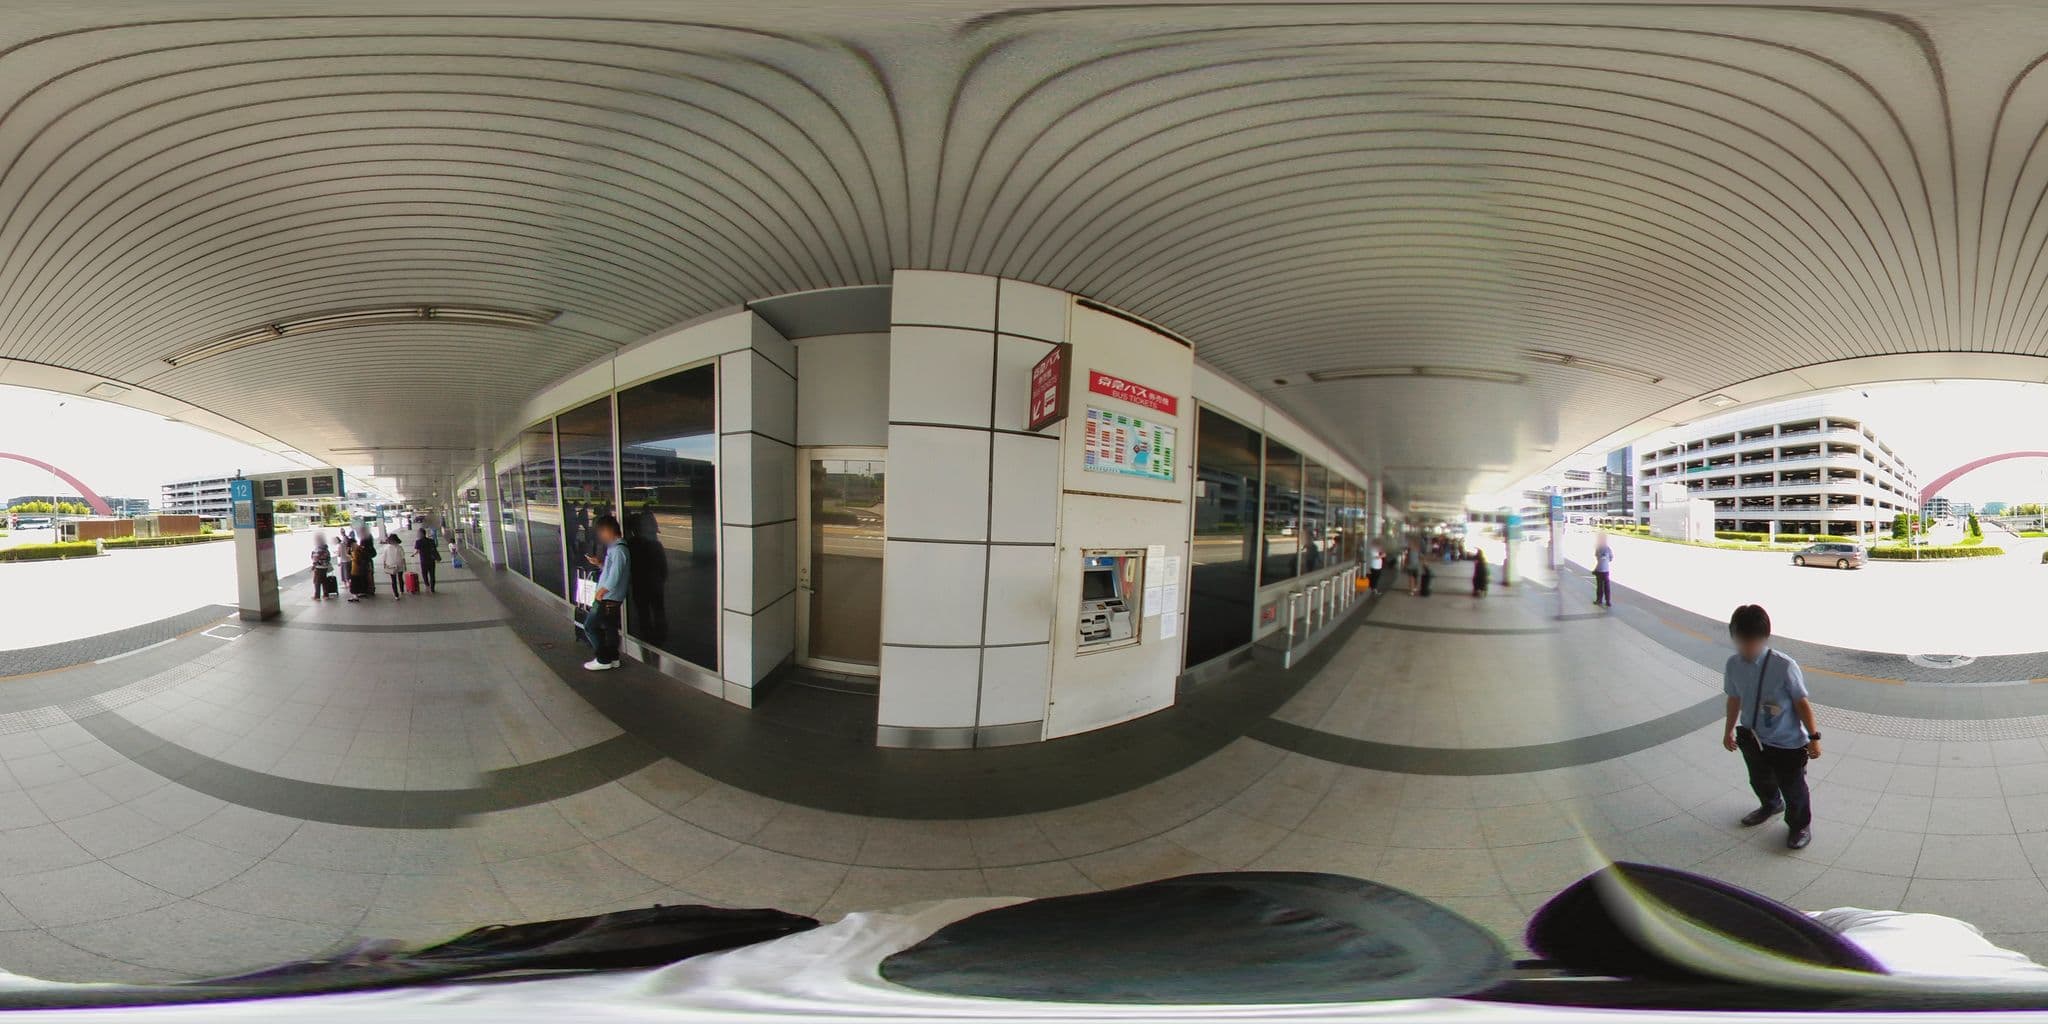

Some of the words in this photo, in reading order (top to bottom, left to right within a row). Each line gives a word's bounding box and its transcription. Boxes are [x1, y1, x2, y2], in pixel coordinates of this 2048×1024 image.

[1098, 376, 1147, 398] 京急バス
[1112, 390, 1128, 400] BUS
[237, 484, 247, 497] 12
